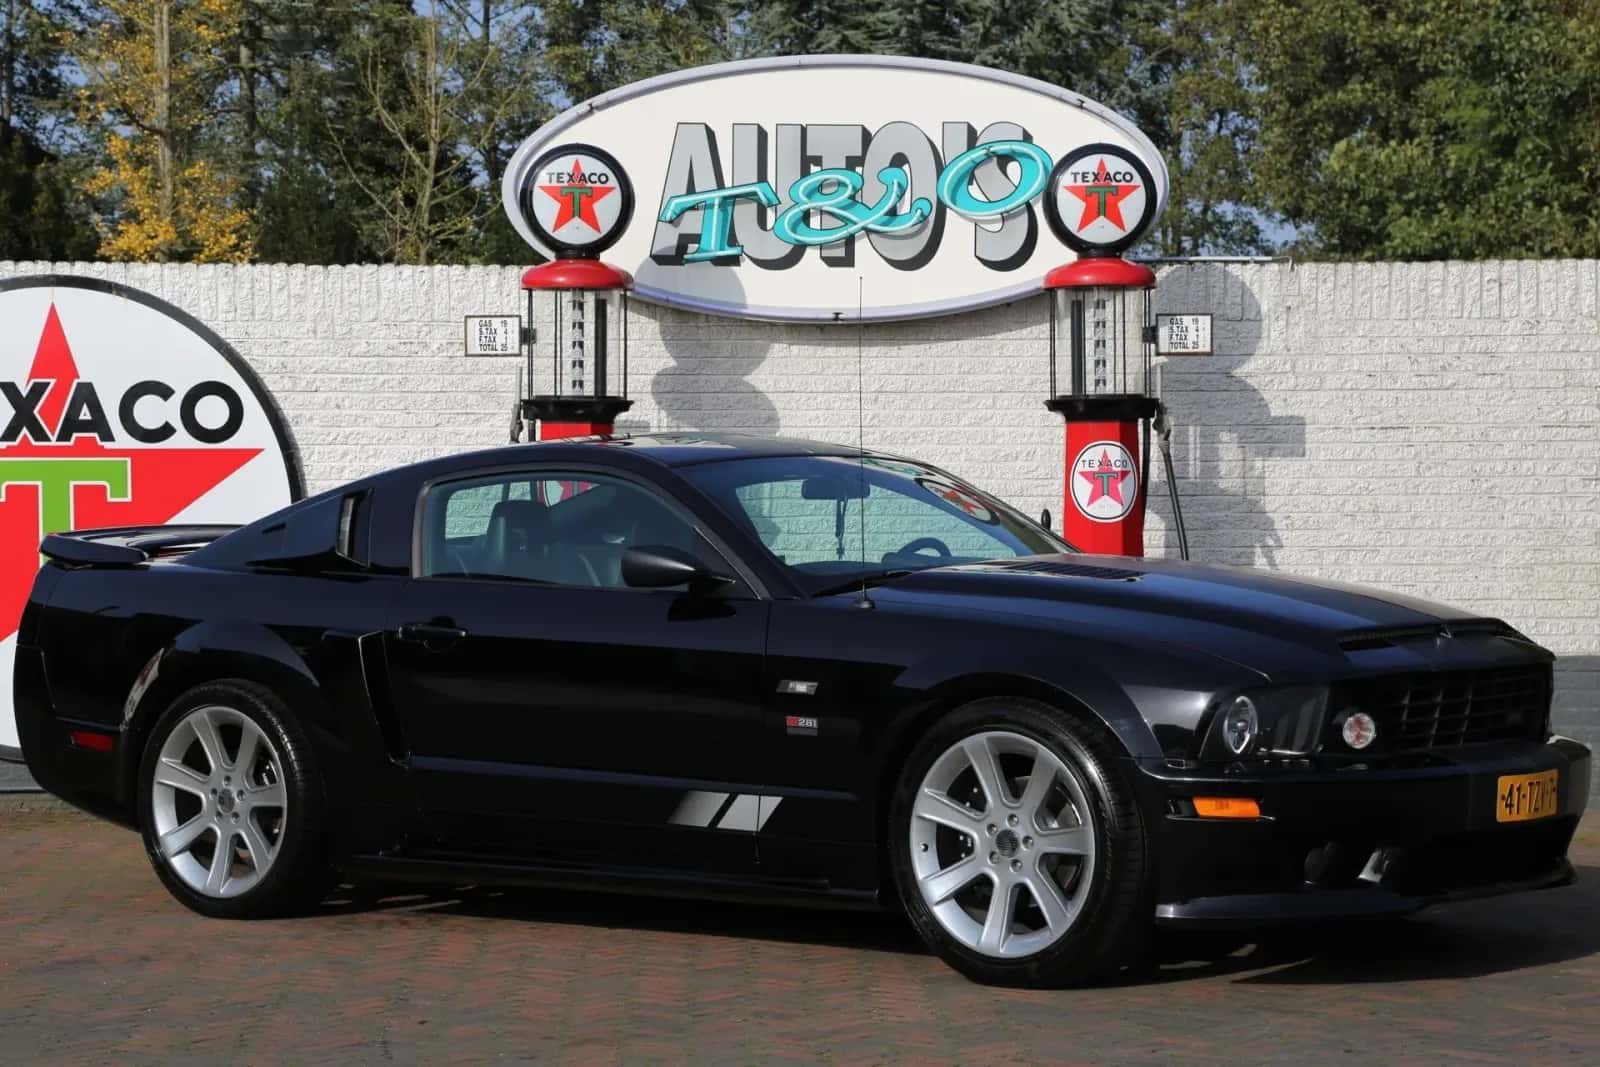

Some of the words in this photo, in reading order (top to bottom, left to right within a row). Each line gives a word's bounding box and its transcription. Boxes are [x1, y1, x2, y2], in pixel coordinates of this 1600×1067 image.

[546, 172, 609, 185] TEXACO
[1071, 171, 1134, 183] TEXACO
[650, 121, 1038, 271] AUTO'S
[479, 319, 492, 328] GAS
[1170, 317, 1184, 326] GAS
[479, 343, 499, 352] TOTAL
[1170, 341, 1190, 350] TOTAL
[1081, 459, 1128, 469] TEXACO
